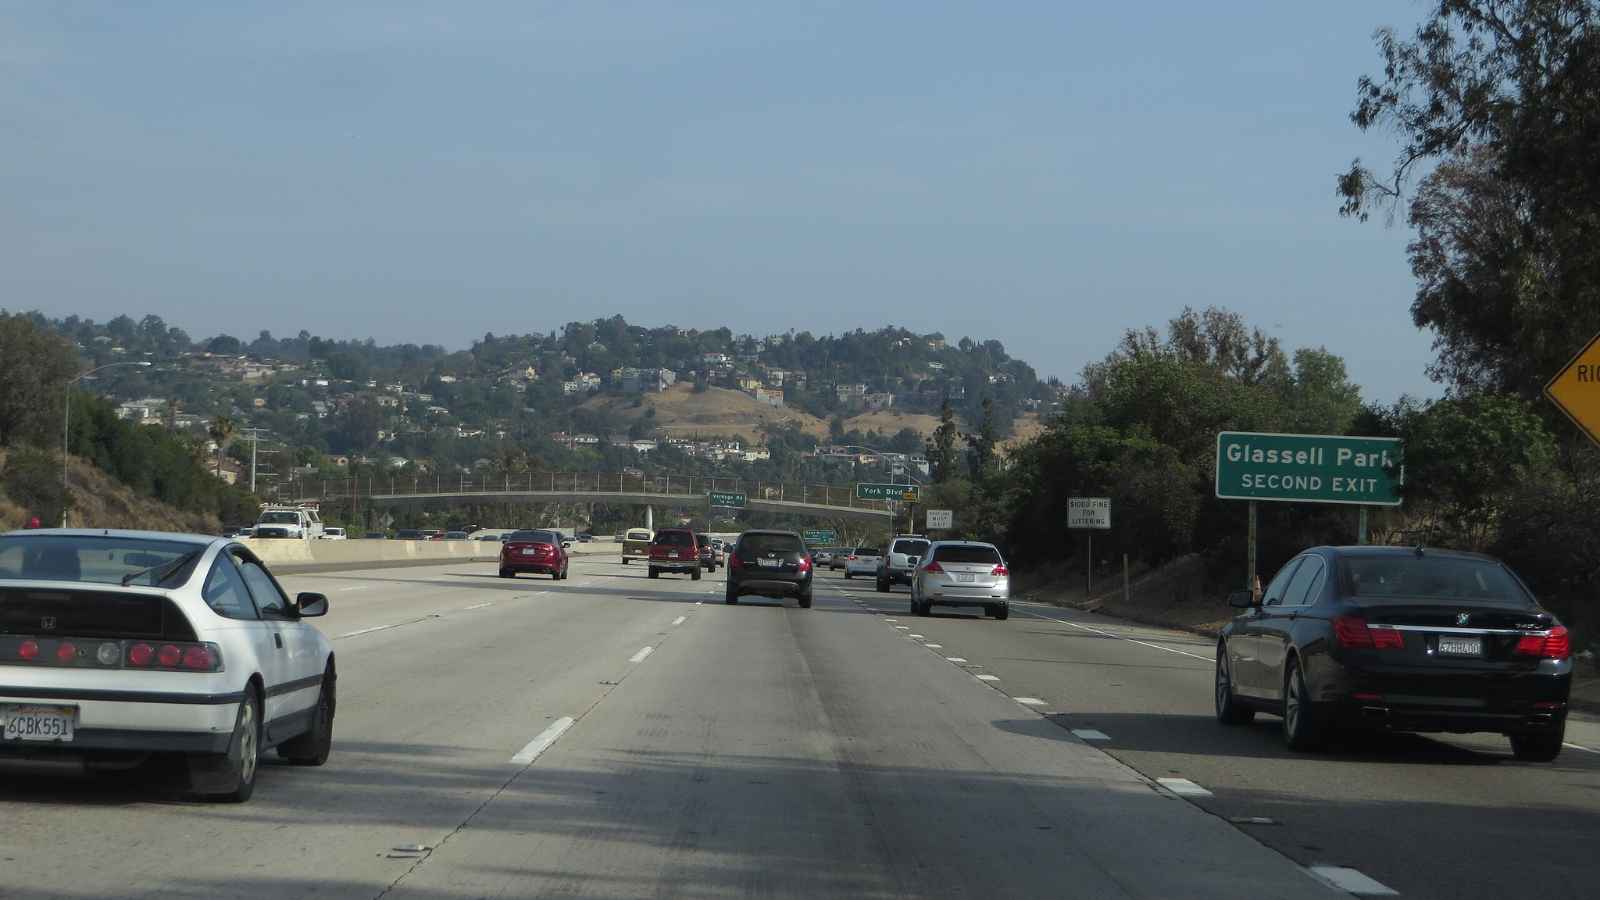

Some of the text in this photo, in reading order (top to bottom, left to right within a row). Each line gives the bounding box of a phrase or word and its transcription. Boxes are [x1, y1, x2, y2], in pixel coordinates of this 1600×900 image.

[1226, 443, 1393, 468] Glassell Park
[863, 487, 903, 496] York Blvd
[1241, 473, 1378, 493] SECOND EXIT
[1092, 500, 1107, 508] FINE
[8, 717, 68, 736] 6CBK551
